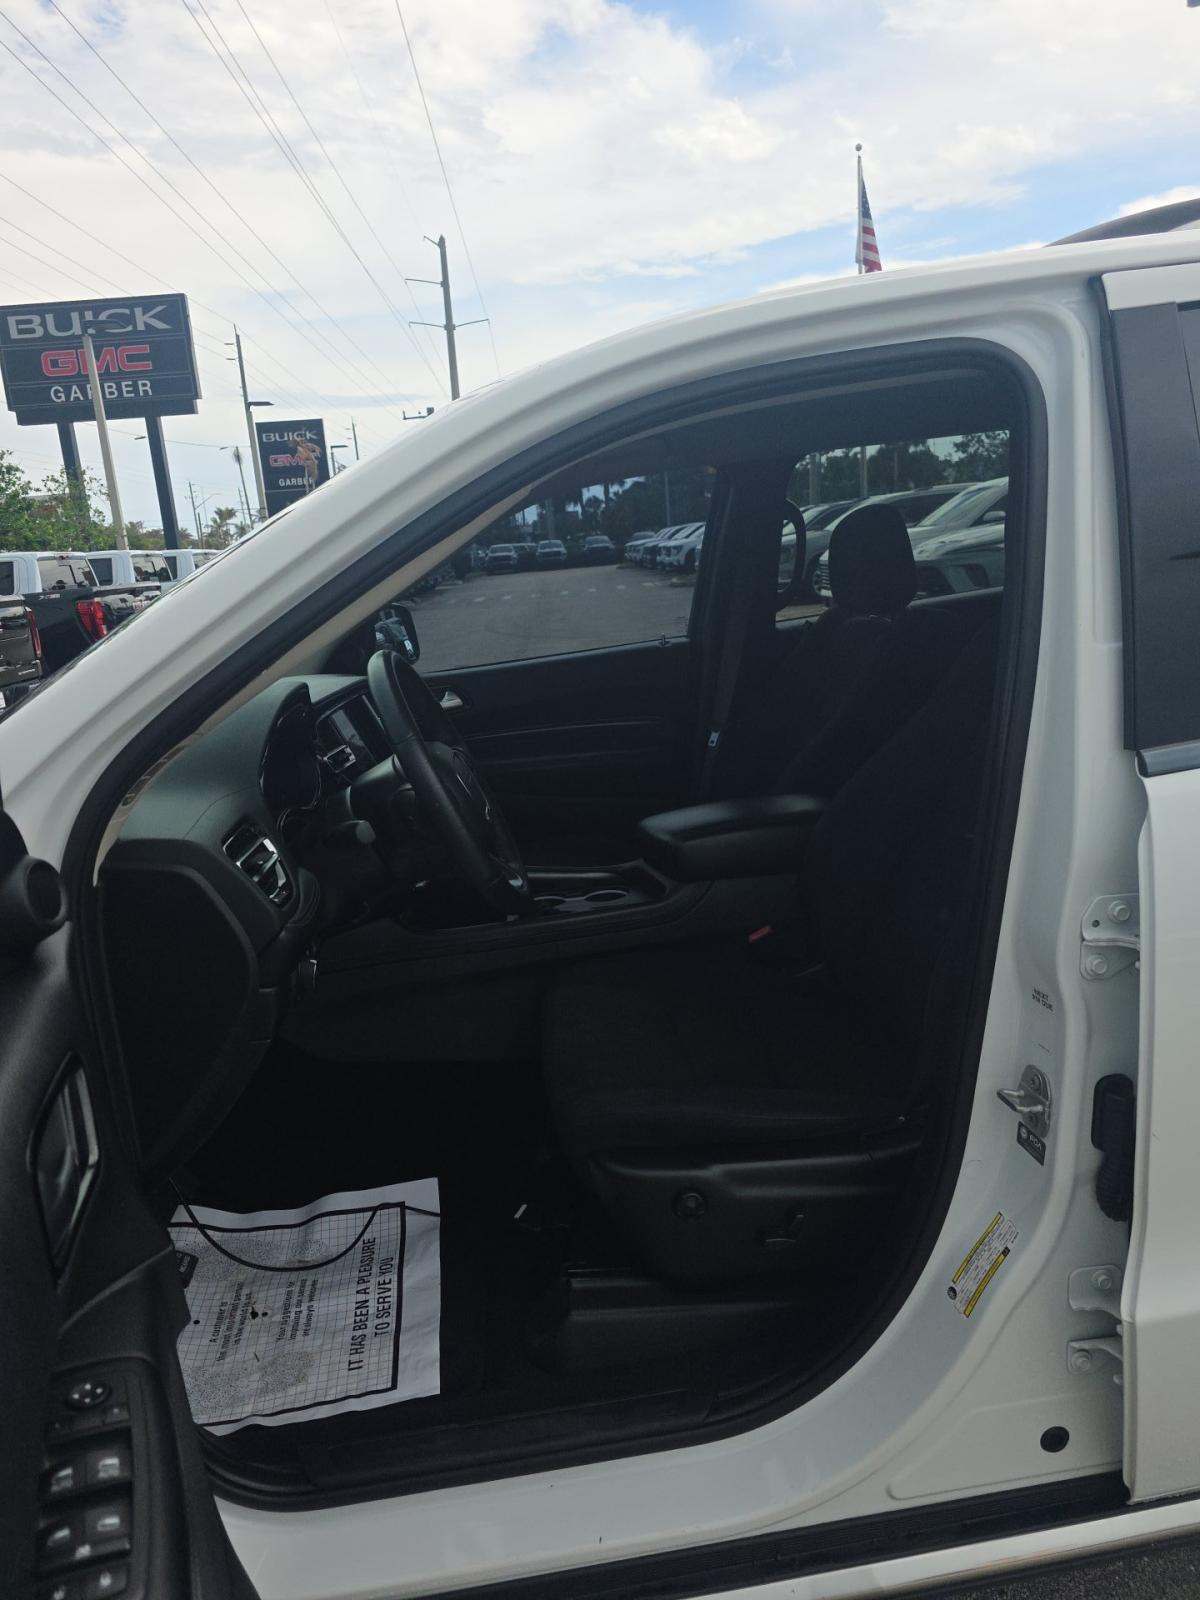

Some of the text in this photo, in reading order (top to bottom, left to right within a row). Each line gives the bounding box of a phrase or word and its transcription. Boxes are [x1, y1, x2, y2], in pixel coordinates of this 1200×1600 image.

[262, 430, 320, 442] BUICK
[348, 1237, 376, 1371] IT HAS BEEN A PLEASURE
[374, 1256, 394, 1337] TO SERVE YOU
